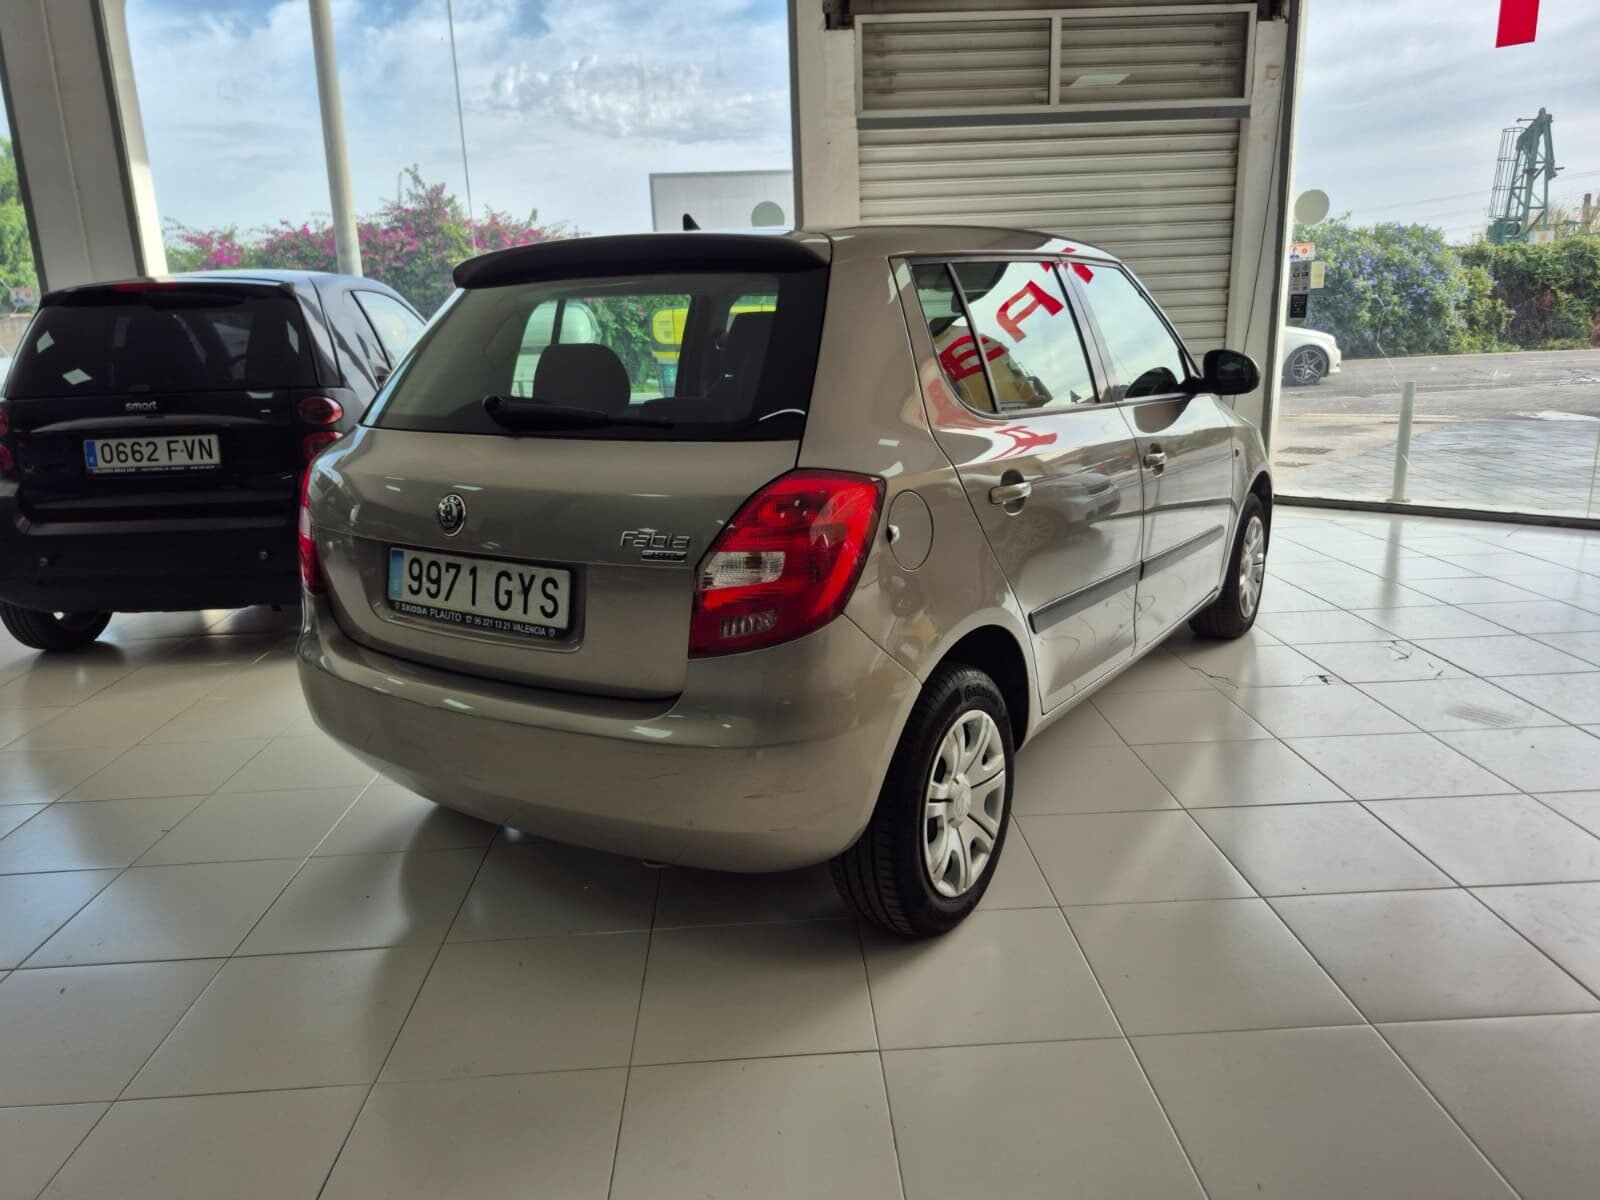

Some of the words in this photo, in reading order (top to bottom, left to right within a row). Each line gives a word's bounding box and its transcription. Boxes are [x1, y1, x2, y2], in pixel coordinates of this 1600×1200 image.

[125, 400, 158, 411] smart
[100, 441, 160, 464] 0662
[166, 438, 214, 462] FVN
[619, 530, 691, 549] Fabia
[408, 557, 478, 607] 9971
[494, 570, 560, 619] GYS
[401, 602, 428, 615] SKODA
[430, 608, 462, 622] PLAUTO
[512, 623, 546, 636] VALENCIA
